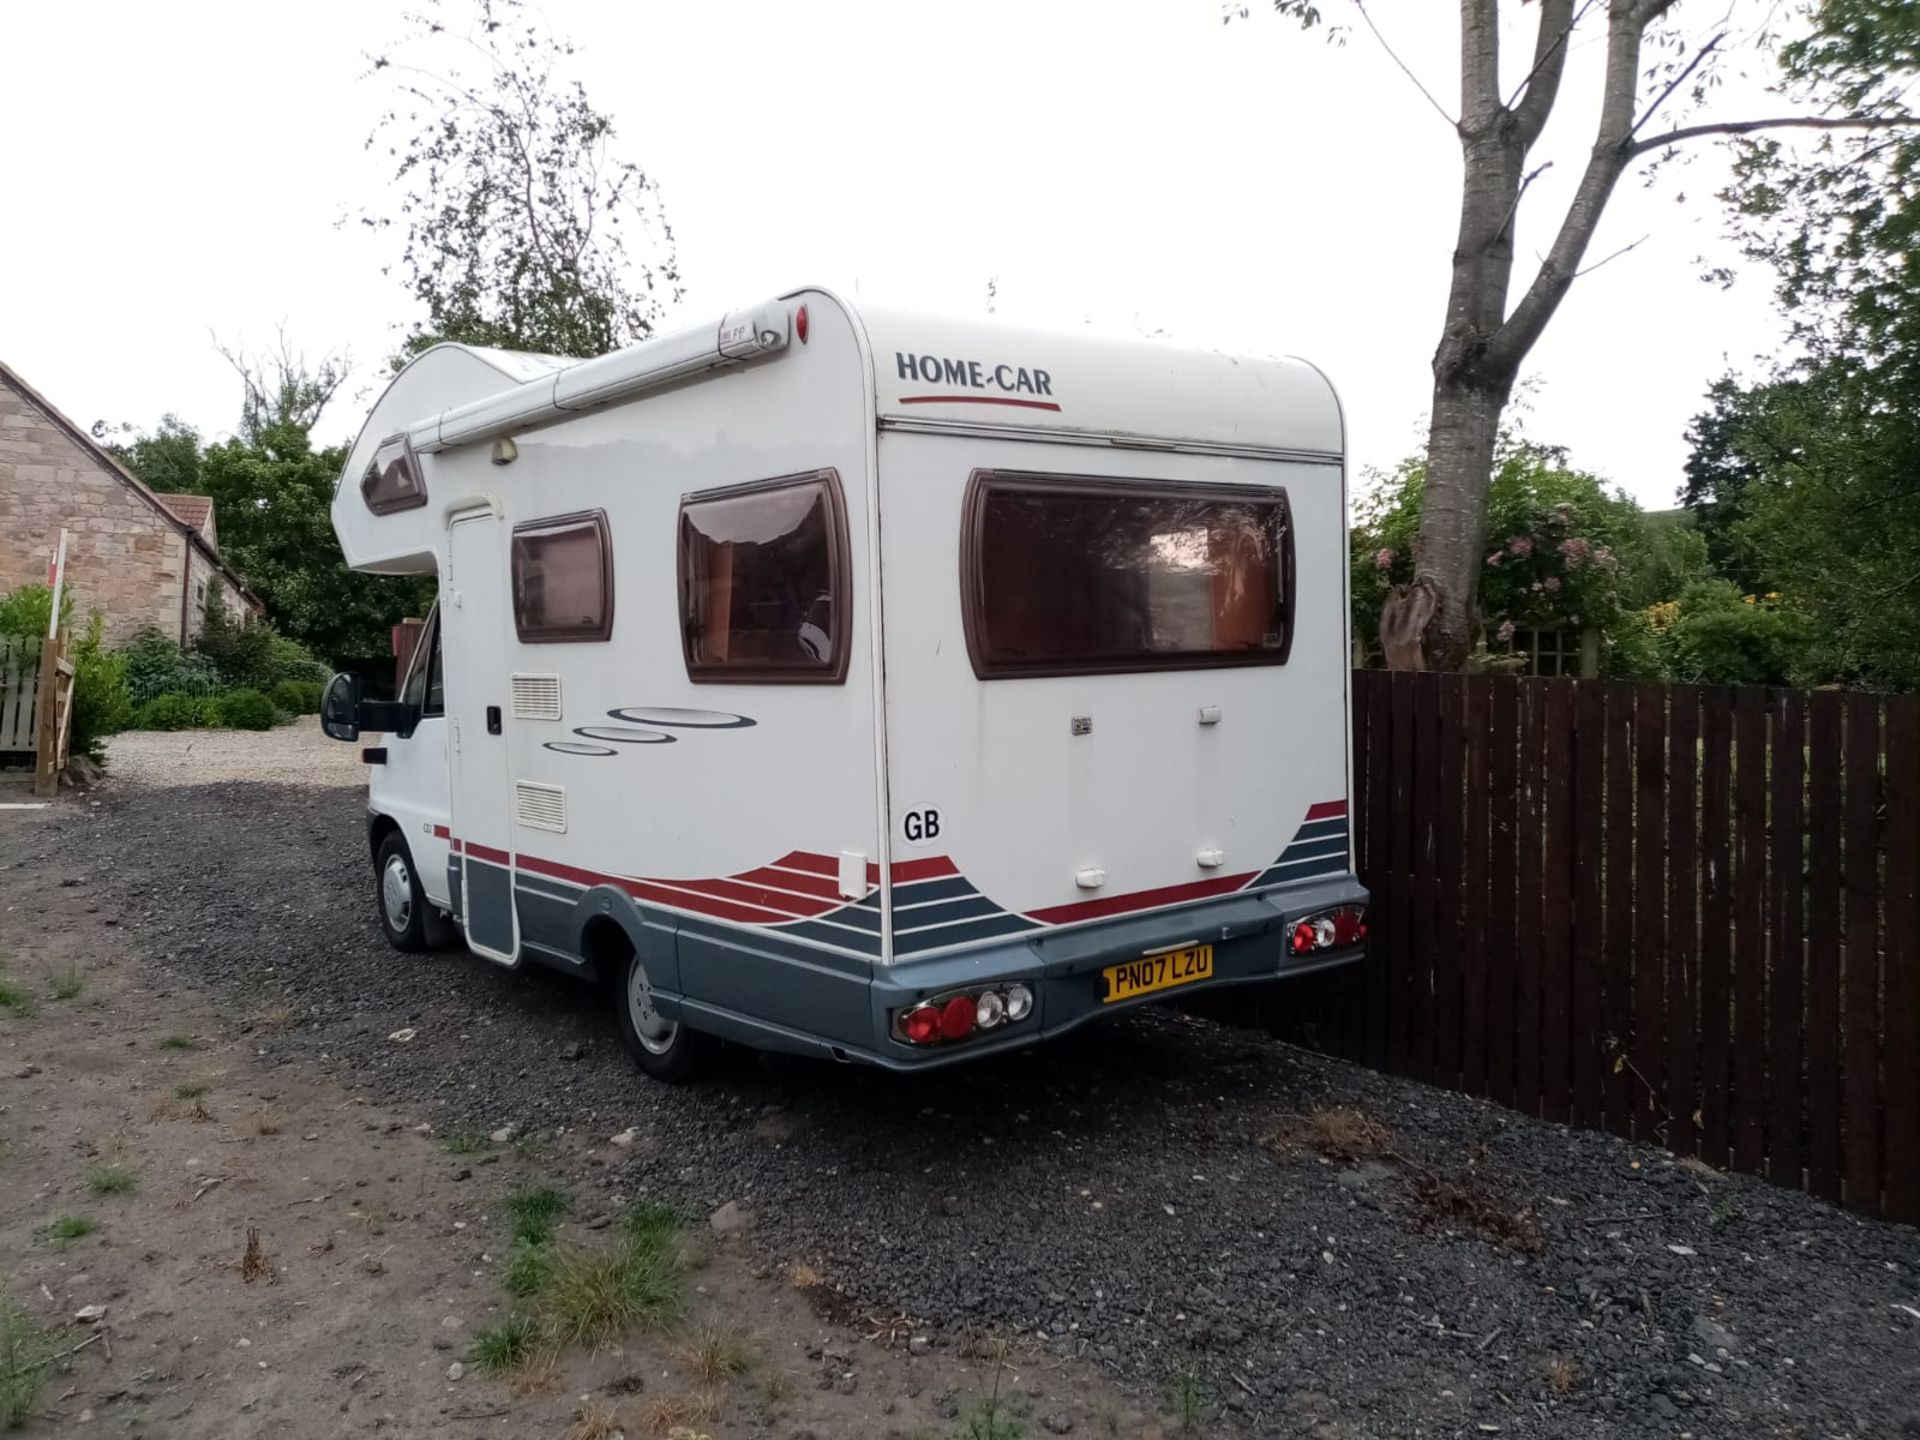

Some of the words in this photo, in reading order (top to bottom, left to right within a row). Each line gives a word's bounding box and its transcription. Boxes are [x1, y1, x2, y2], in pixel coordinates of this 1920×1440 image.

[895, 352, 1053, 396] HOME-CAR
[905, 810, 939, 841] GB
[1116, 958, 1167, 993] PN07
[1172, 948, 1208, 979] LZU
